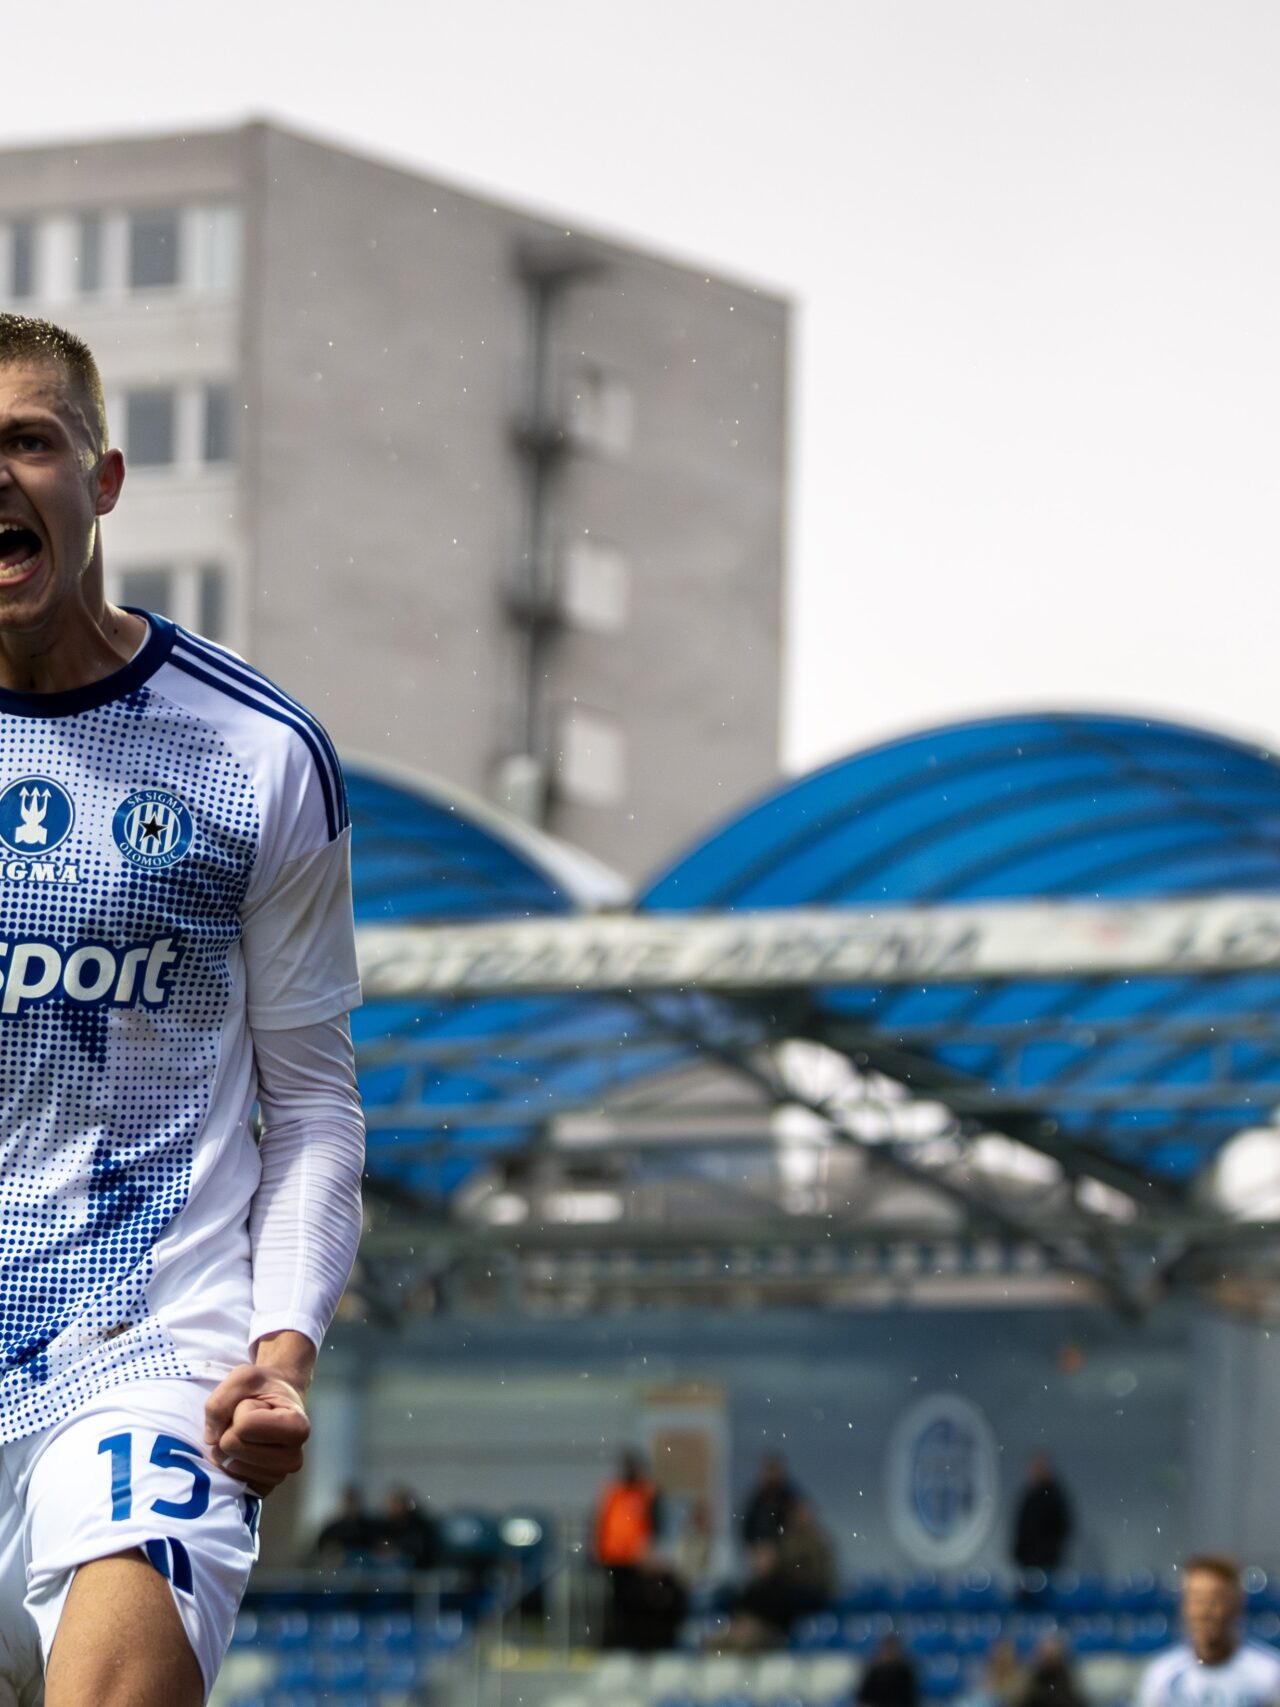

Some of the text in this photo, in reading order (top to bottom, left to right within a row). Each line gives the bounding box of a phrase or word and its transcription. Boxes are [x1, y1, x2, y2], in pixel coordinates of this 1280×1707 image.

[126, 792, 184, 816] SK SIGMA
[119, 842, 181, 867] OLOMOUC
[97, 1432, 211, 1522] 15
